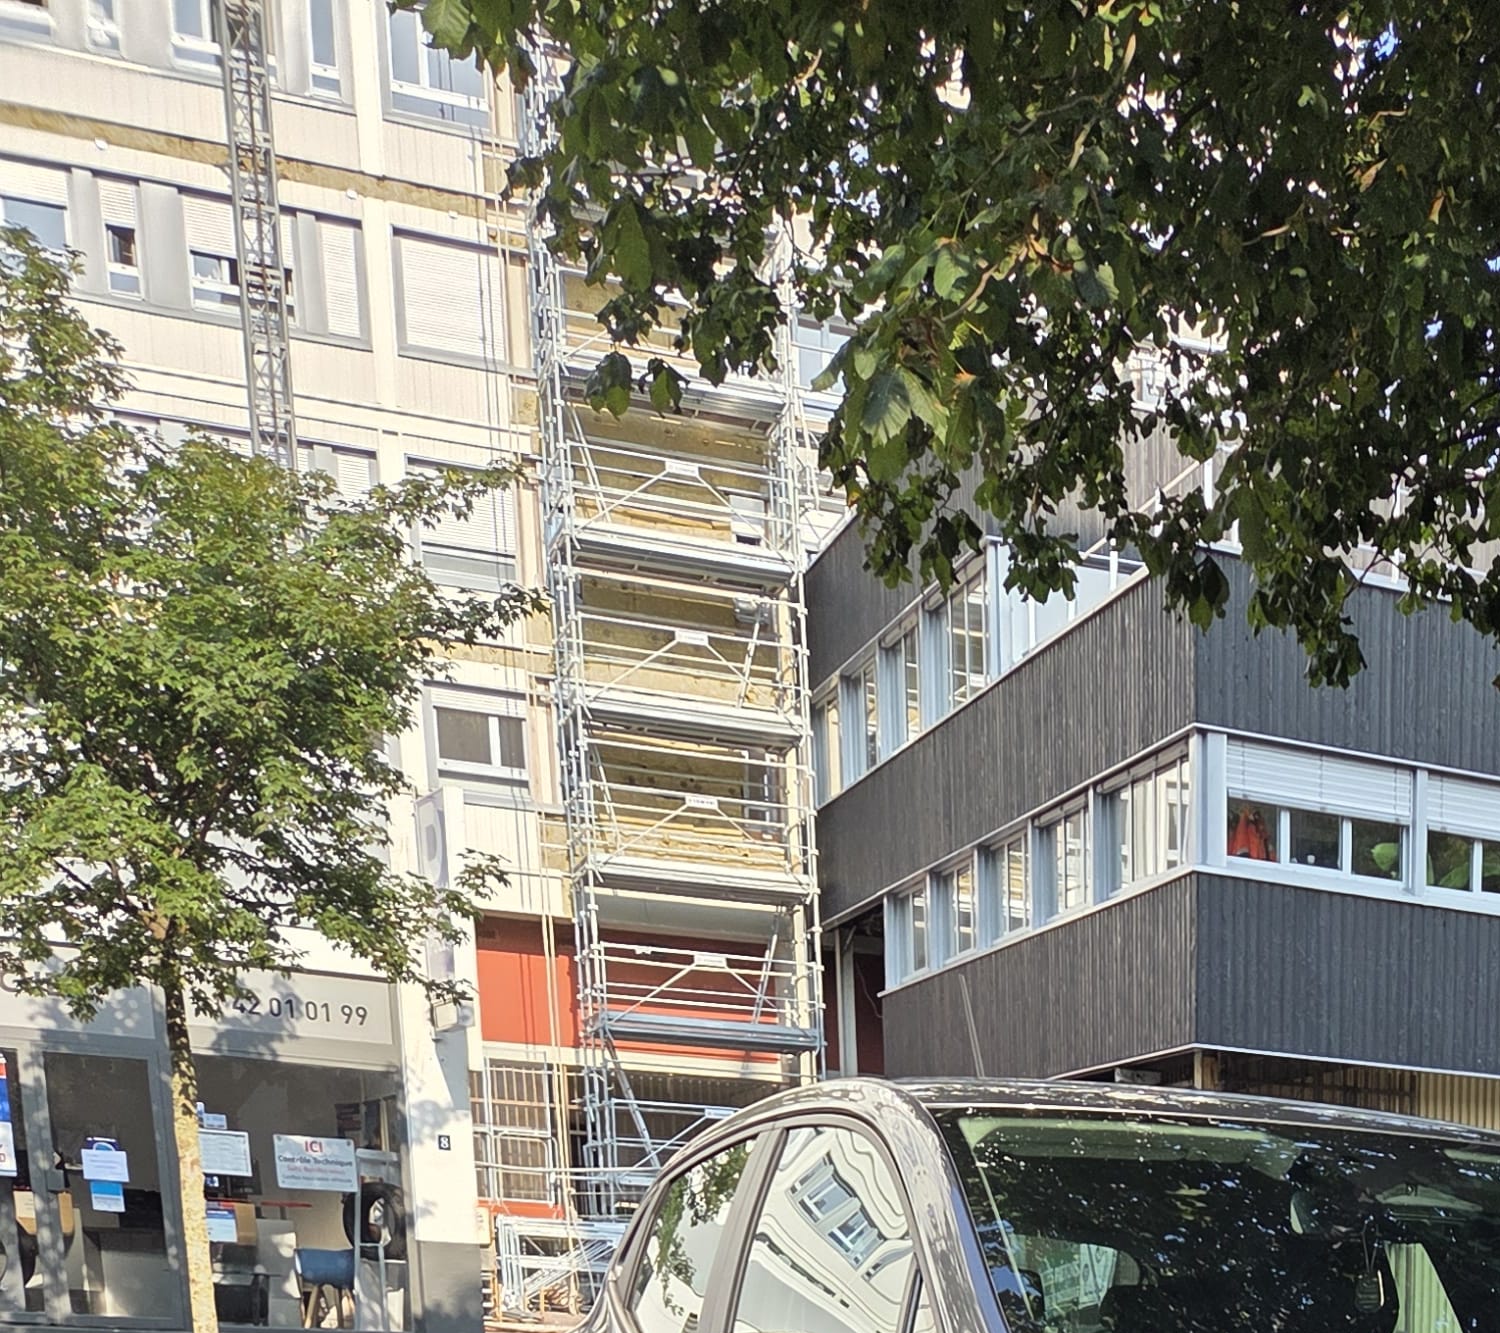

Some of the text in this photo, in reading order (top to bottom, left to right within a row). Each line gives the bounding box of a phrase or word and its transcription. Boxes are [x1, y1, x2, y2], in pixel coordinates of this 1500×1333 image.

[232, 997, 368, 1026] 42 01 01 99
[305, 1140, 324, 1153] ICI
[440, 1136, 449, 1149] 8
